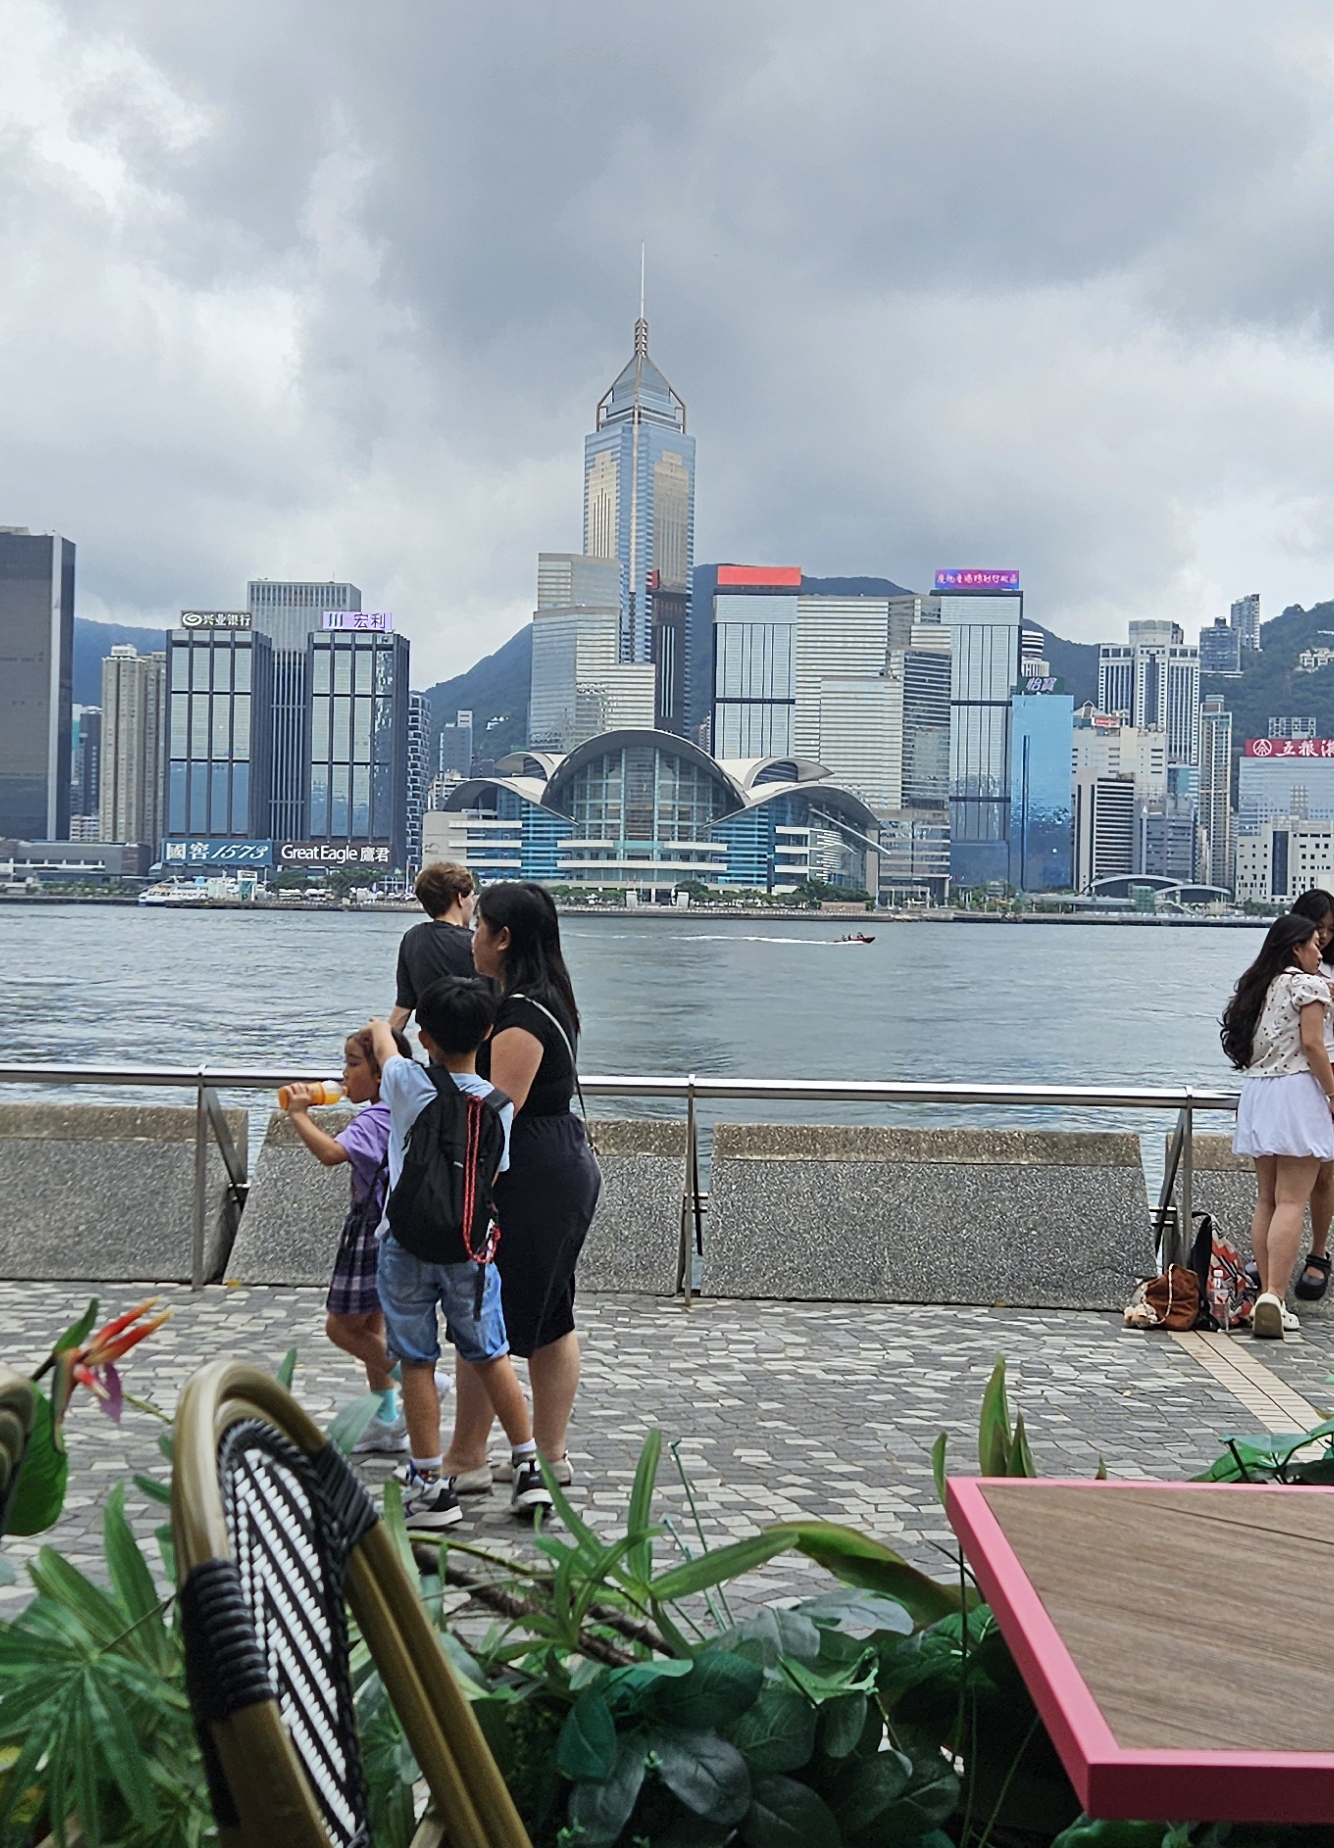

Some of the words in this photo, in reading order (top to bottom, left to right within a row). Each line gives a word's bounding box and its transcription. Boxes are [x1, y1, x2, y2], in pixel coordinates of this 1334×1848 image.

[354, 613, 385, 628] 宏利
[211, 845, 268, 859] 1573
[282, 845, 319, 860] Great
[320, 845, 358, 864] Eagle
[360, 847, 391, 863] 鷹君
